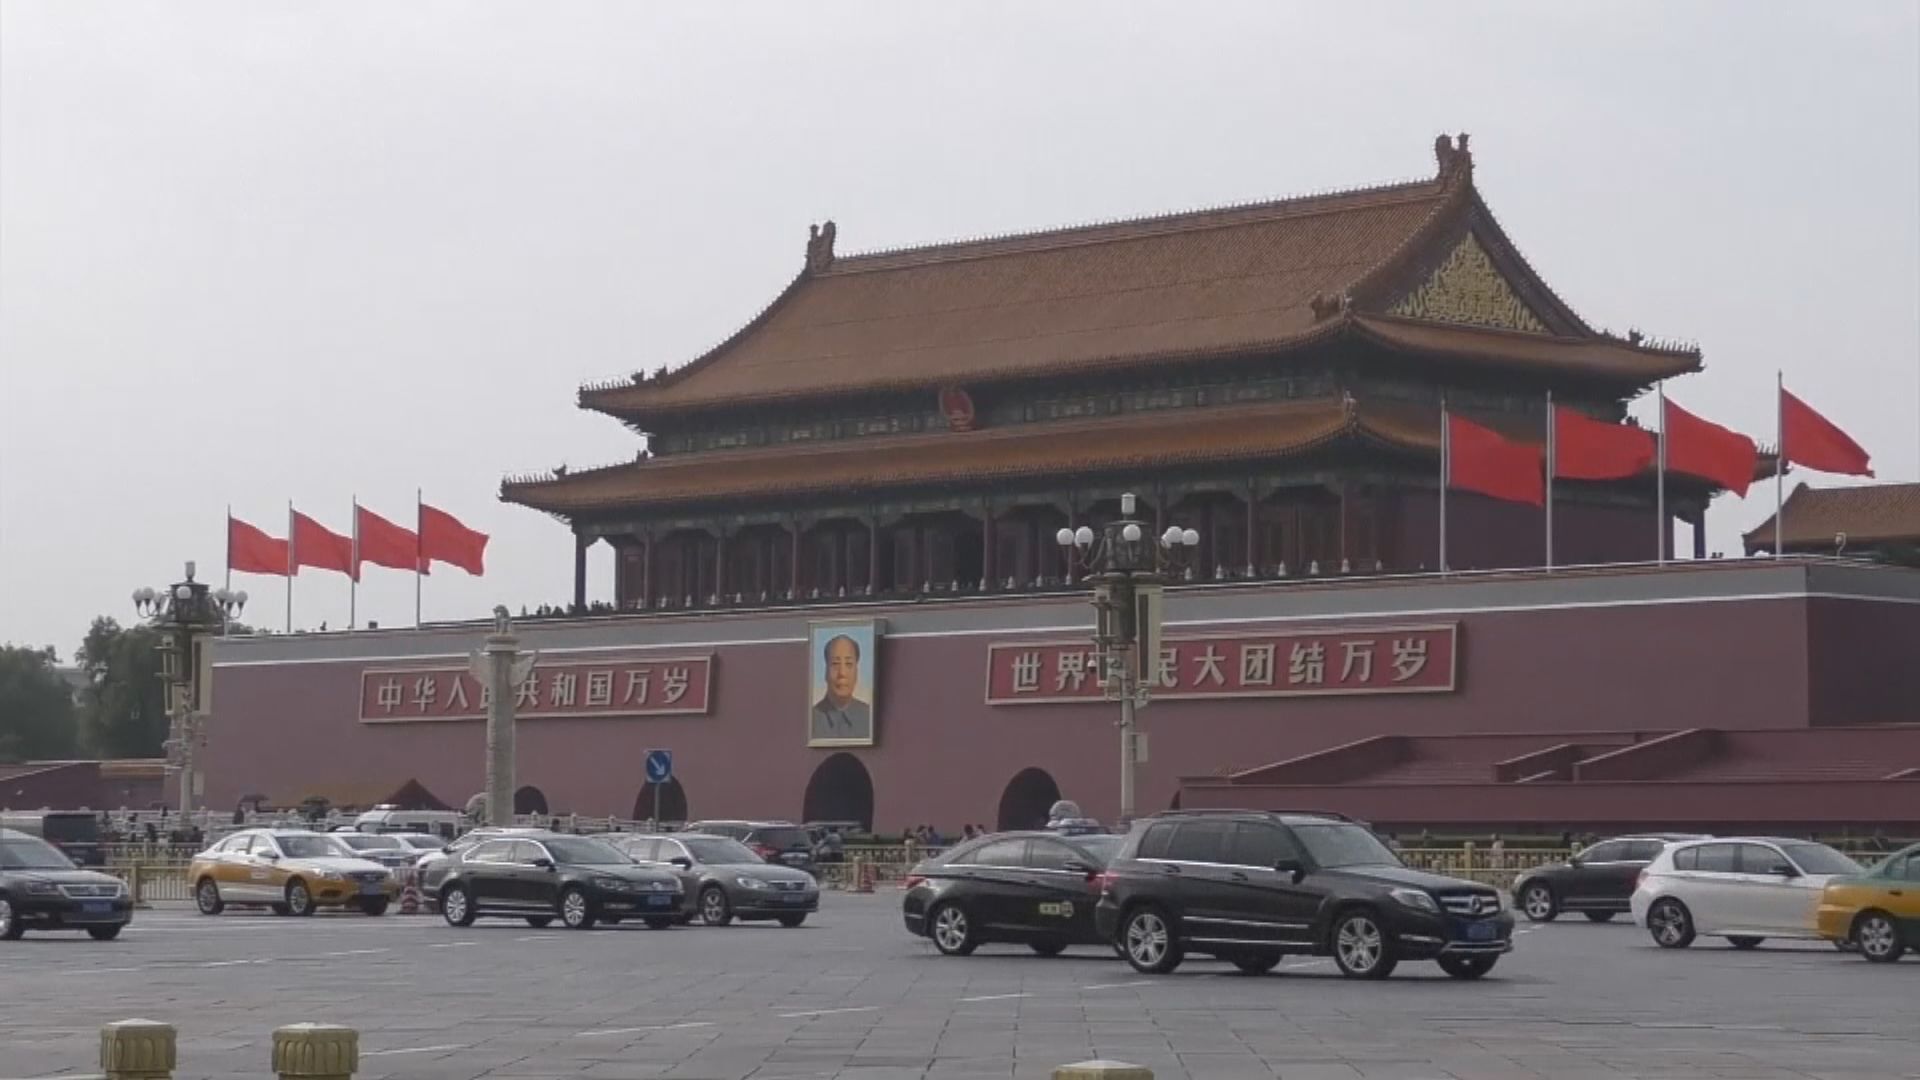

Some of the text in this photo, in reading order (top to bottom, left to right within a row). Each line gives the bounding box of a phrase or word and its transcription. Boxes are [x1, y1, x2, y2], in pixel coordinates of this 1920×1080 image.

[1010, 637, 1429, 693] 世界民大团结万岁
